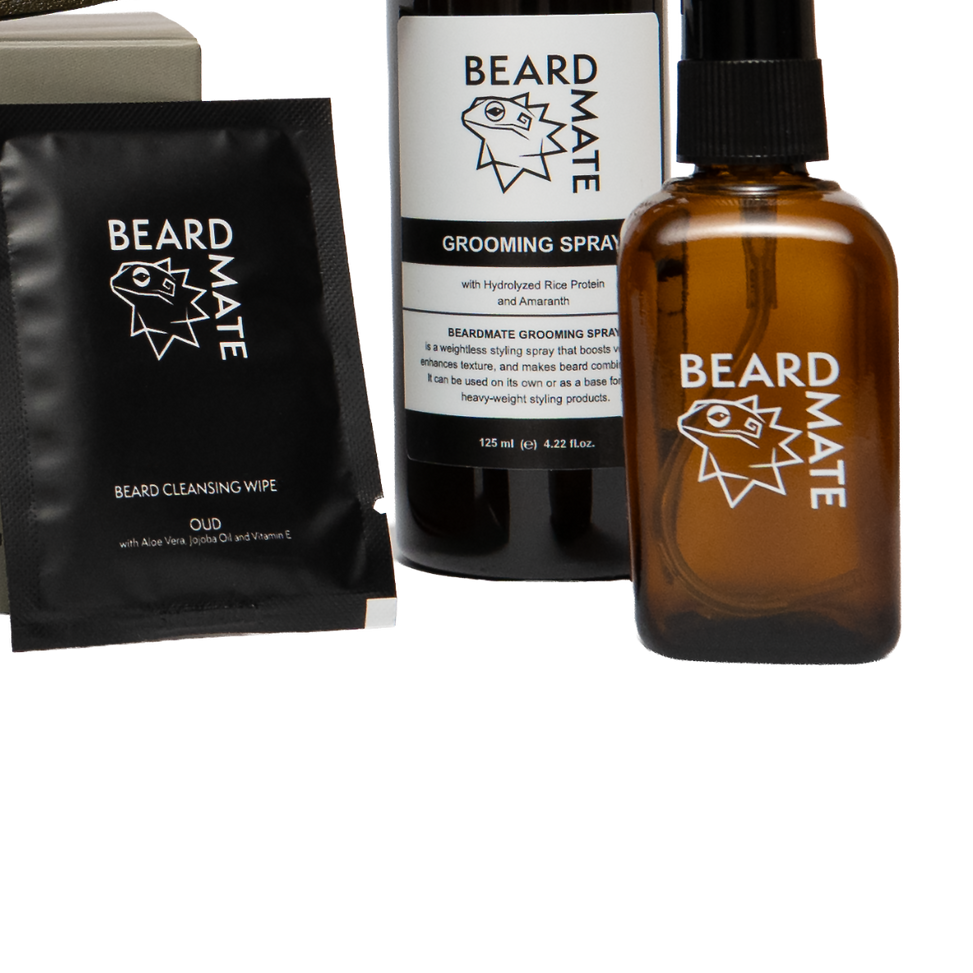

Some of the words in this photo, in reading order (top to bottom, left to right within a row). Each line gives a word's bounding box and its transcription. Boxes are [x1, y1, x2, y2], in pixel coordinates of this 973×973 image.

[465, 54, 597, 86] BEARD
[571, 89, 600, 194] MATE
[108, 218, 233, 251] BEARD
[442, 235, 553, 253] GROOMING
[461, 279, 480, 290] with
[484, 279, 540, 292] Hydrolyzed
[544, 279, 567, 290] Rice
[571, 278, 605, 290] Protein
[208, 252, 248, 360] MATE
[497, 296, 516, 306] and
[519, 296, 569, 306] Amaranth
[448, 328, 515, 338] BEARDMATE
[519, 330, 584, 339] GROOMING
[425, 342, 431, 351] is
[440, 344, 487, 354] weightless
[491, 345, 522, 357] styling
[526, 348, 554, 357] spray
[558, 346, 577, 355] that
[580, 345, 611, 354] boosts
[421, 358, 458, 369] enhances
[461, 361, 496, 372] texture,
[500, 363, 518, 371] and
[522, 362, 556, 371] makes
[560, 361, 587, 370] beard
[680, 352, 839, 388] BEARD
[434, 376, 448, 384] can
[451, 376, 462, 385] be
[465, 378, 488, 386] used
[491, 379, 503, 387] on
[507, 378, 518, 387] its
[574, 379, 580, 387] a
[584, 378, 607, 386] base
[462, 392, 526, 405] heavy-weight
[530, 394, 562, 405] styling
[566, 393, 610, 405] products.
[479, 438, 497, 447] 125
[501, 439, 514, 448] ml
[543, 440, 566, 448] 4.22
[805, 391, 847, 509] MATE
[115, 484, 159, 498] BEARD
[162, 481, 241, 496] CLEANSING
[244, 479, 277, 492] WIPE
[190, 517, 221, 531] OUD
[119, 538, 139, 548] with
[141, 538, 162, 547] Aloe
[189, 534, 217, 546] Jojoba
[219, 533, 232, 542] Oil
[234, 532, 250, 541] and
[251, 531, 283, 540] Vitamin
[285, 530, 292, 539] E
